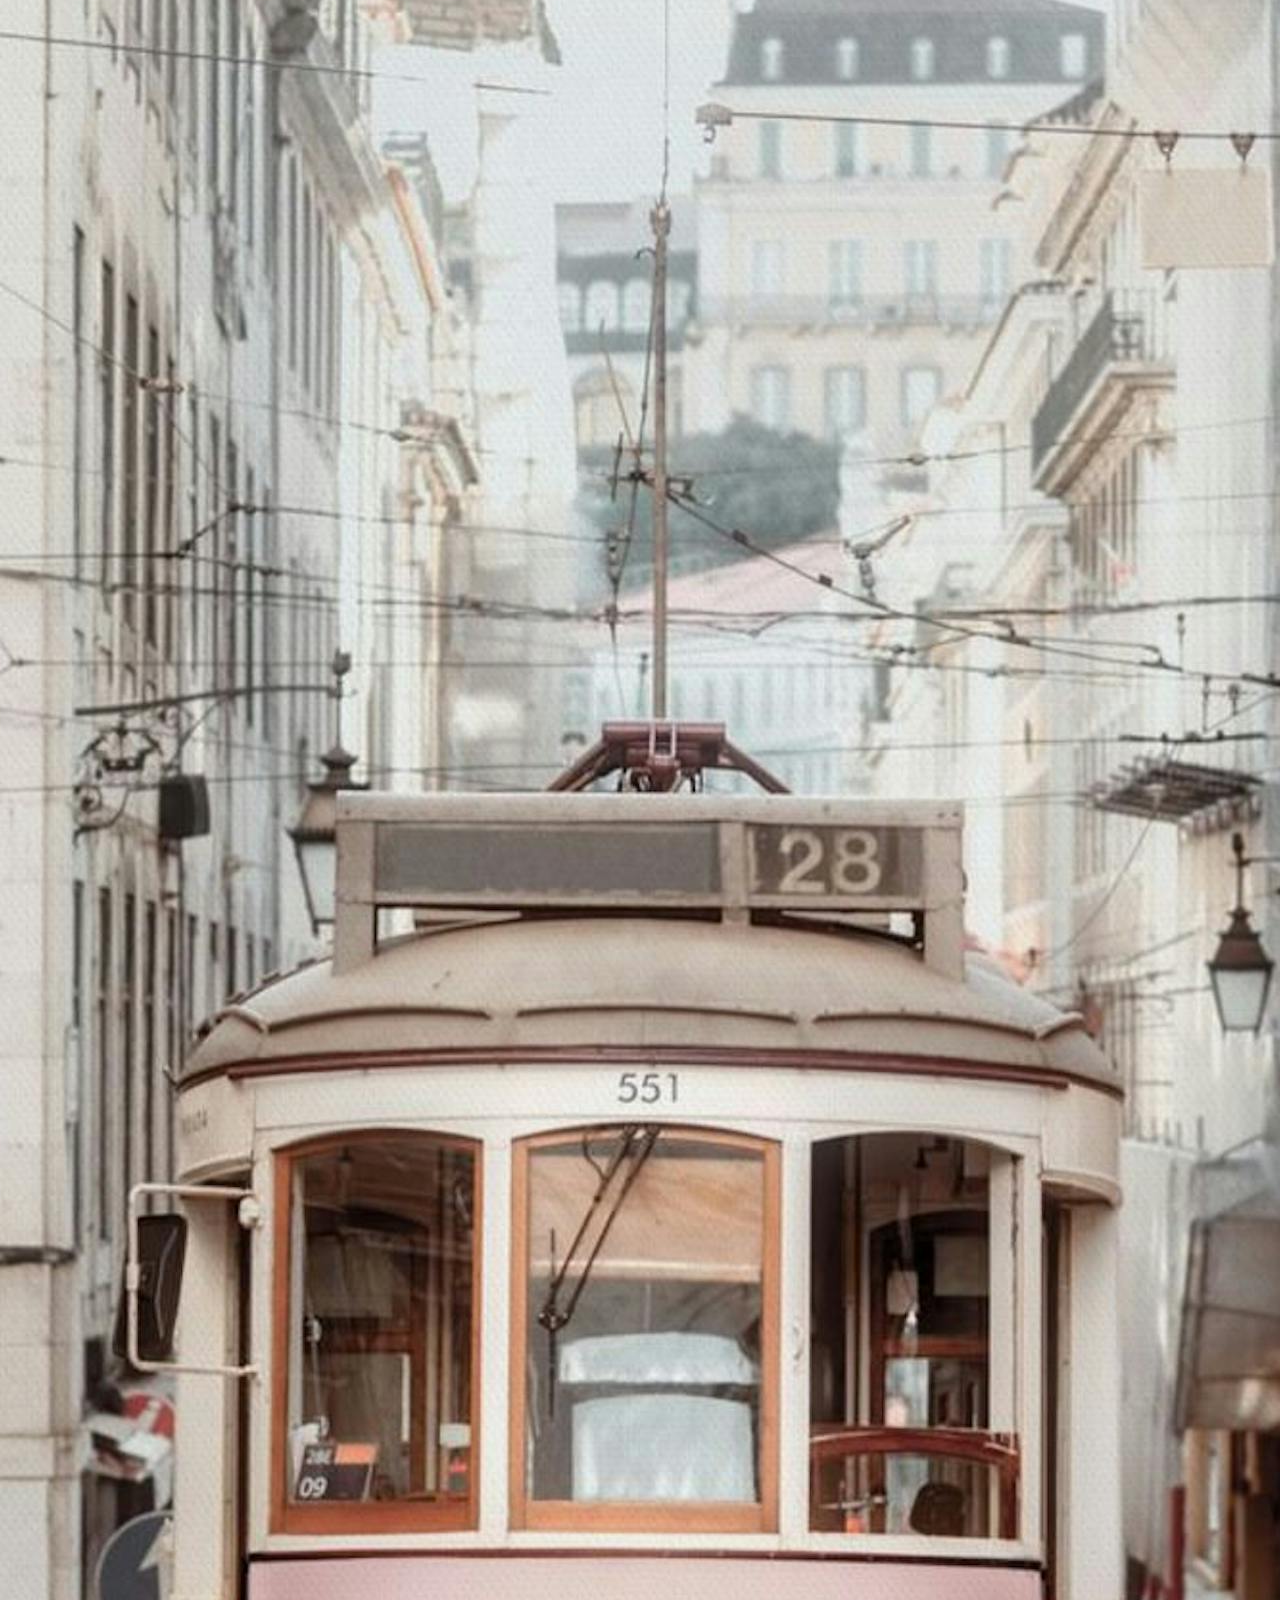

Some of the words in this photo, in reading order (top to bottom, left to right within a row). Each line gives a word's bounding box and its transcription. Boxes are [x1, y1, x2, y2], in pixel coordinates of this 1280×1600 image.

[780, 830, 881, 893] 28
[619, 1072, 677, 1103] 551
[300, 1476, 328, 1498] 09
